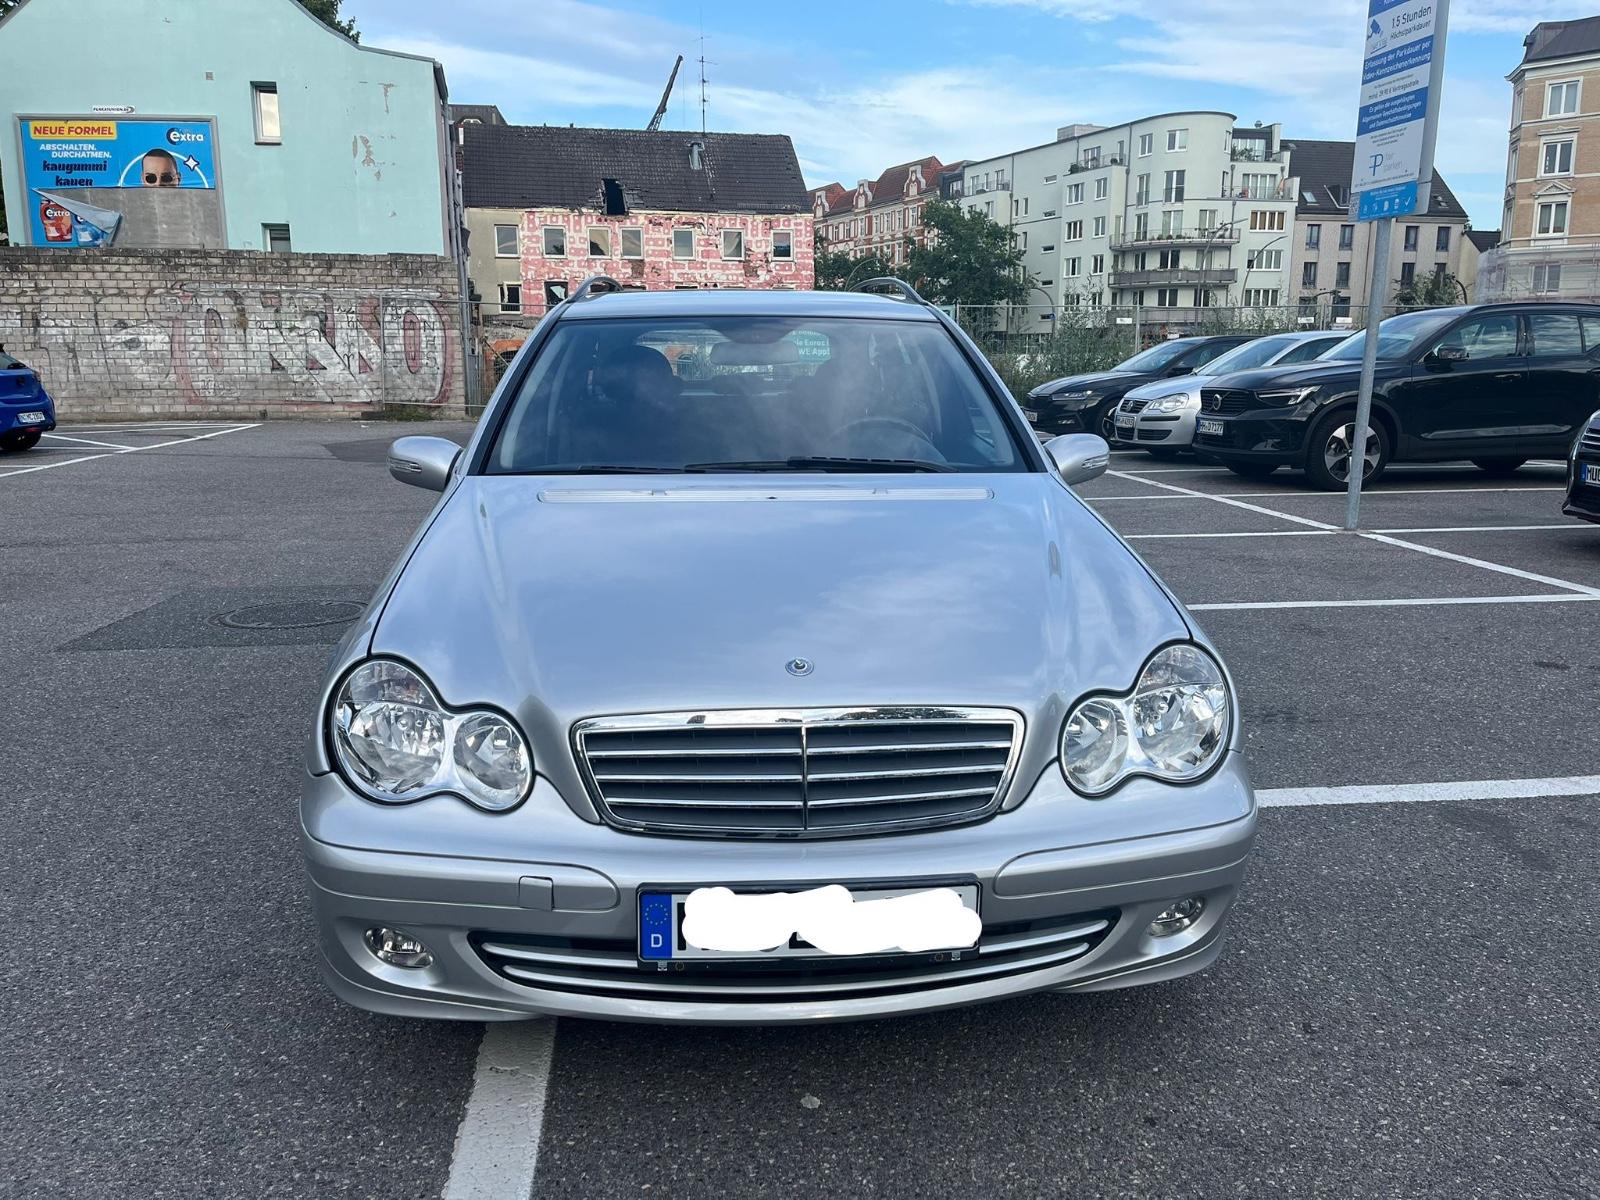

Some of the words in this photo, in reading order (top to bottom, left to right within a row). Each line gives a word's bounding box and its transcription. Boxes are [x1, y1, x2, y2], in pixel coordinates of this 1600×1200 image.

[1402, 6, 1432, 24] Stunden
[1396, 43, 1421, 58] Parkdauer
[1421, 41, 1431, 50] per
[33, 126, 65, 135] NEUE
[68, 126, 114, 135] FORMEL
[170, 131, 204, 141] extra
[42, 160, 107, 174] kaugummi
[55, 176, 93, 186] kauen
[651, 934, 662, 947] D
